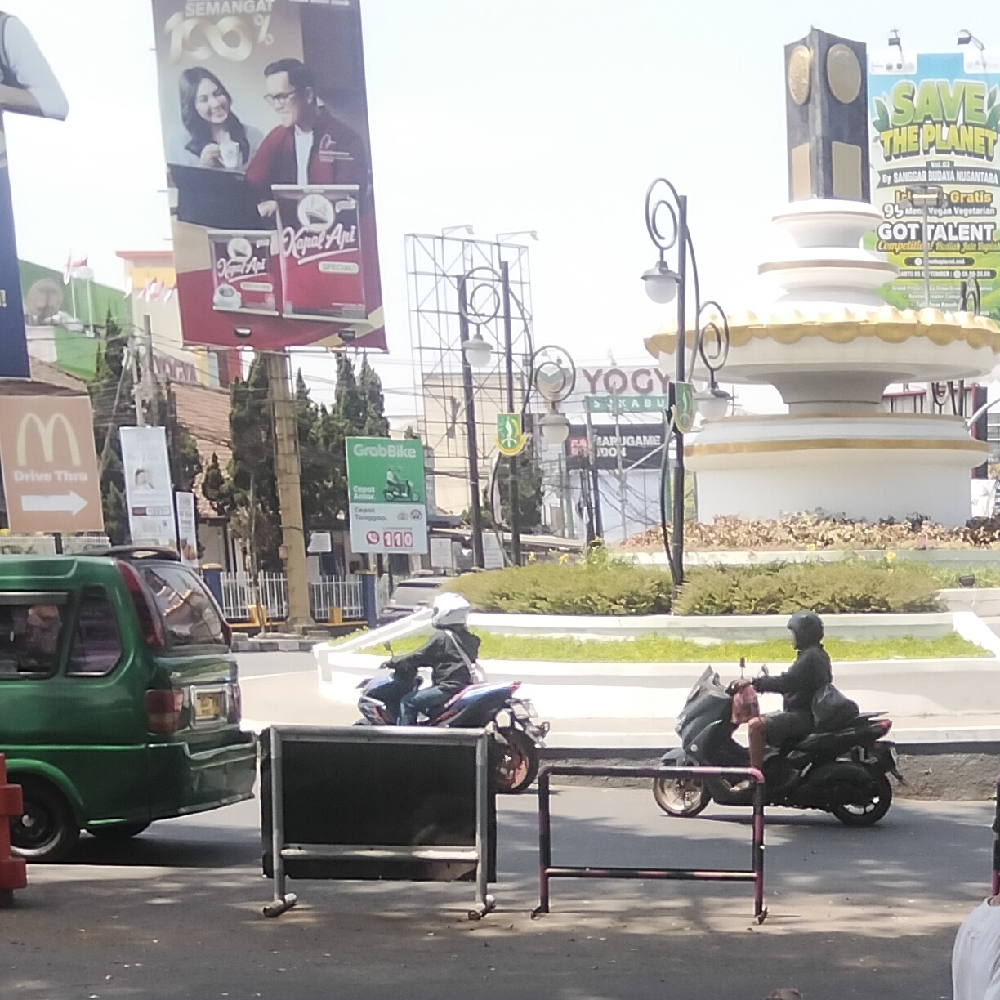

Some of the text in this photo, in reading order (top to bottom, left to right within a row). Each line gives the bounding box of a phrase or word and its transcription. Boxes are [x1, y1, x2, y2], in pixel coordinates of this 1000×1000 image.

[185, 0, 274, 17] SEMANGAT
[164, 11, 274, 64] 100%
[891, 79, 987, 126] SAVE
[880, 124, 998, 160] THE PLANET
[894, 171, 926, 184] SANGGAR
[928, 170, 955, 182] BUDAYA
[956, 171, 998, 184] NUSANTARA
[950, 190, 993, 204] Gratis
[929, 207, 952, 217] Vegan
[954, 207, 995, 218] Vegetarian
[878, 223, 995, 241] GOT TALENT
[282, 224, 356, 258] Kapal Api
[353, 443, 417, 459] GrabBike
[13, 470, 88, 481] Drive Thru
[353, 485, 376, 494] Cepat
[354, 507, 375, 515] Cepat
[383, 531, 413, 547] 110
